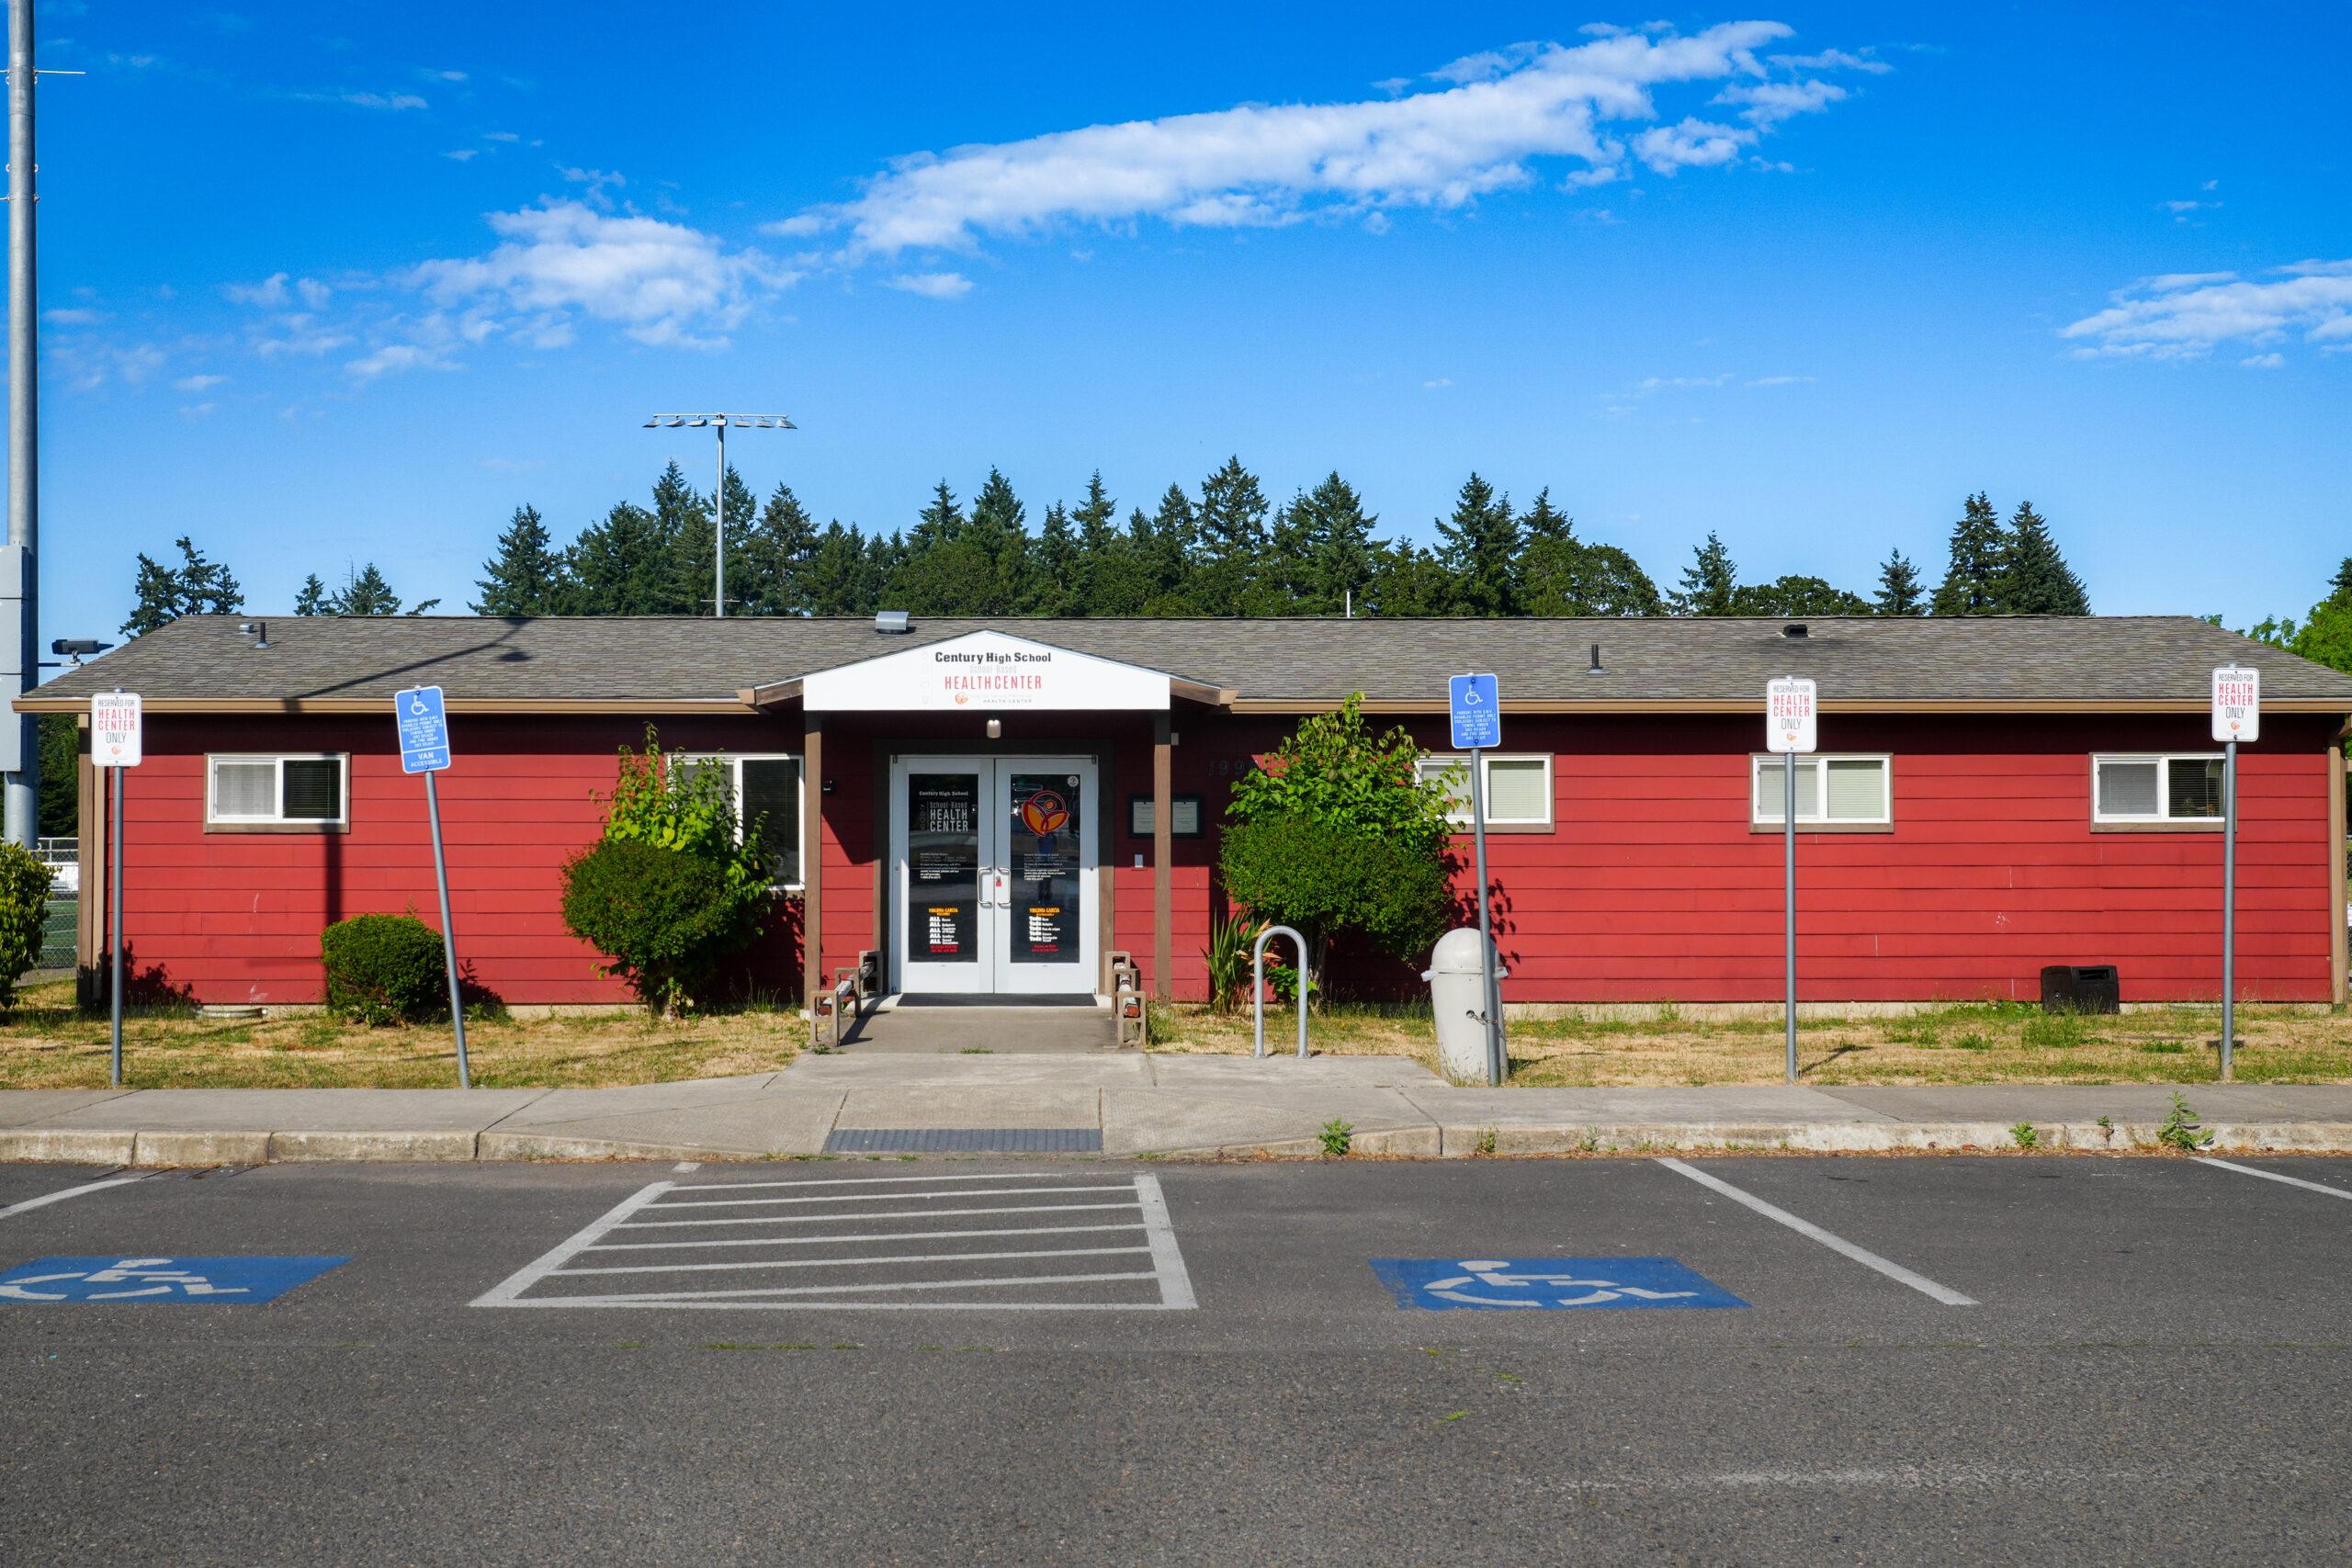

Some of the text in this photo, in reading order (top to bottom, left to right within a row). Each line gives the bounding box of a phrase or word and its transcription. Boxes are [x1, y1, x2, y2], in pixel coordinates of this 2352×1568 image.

[935, 652, 1051, 664] Century High School
[2219, 683, 2253, 694] HEALTH
[1774, 695, 1810, 705] HEALTH
[2219, 695, 2253, 705] CENTER
[98, 709, 135, 719] HEALTH
[1774, 706, 1810, 716] CENTER
[2226, 707, 2245, 718] ONLY
[98, 720, 135, 731] CENTER
[1781, 718, 1801, 729] ONLY
[107, 732, 126, 744] ONLY
[418, 751, 435, 760] VAN
[931, 809, 967, 820] HEALTH
[930, 821, 968, 832] CENTER
